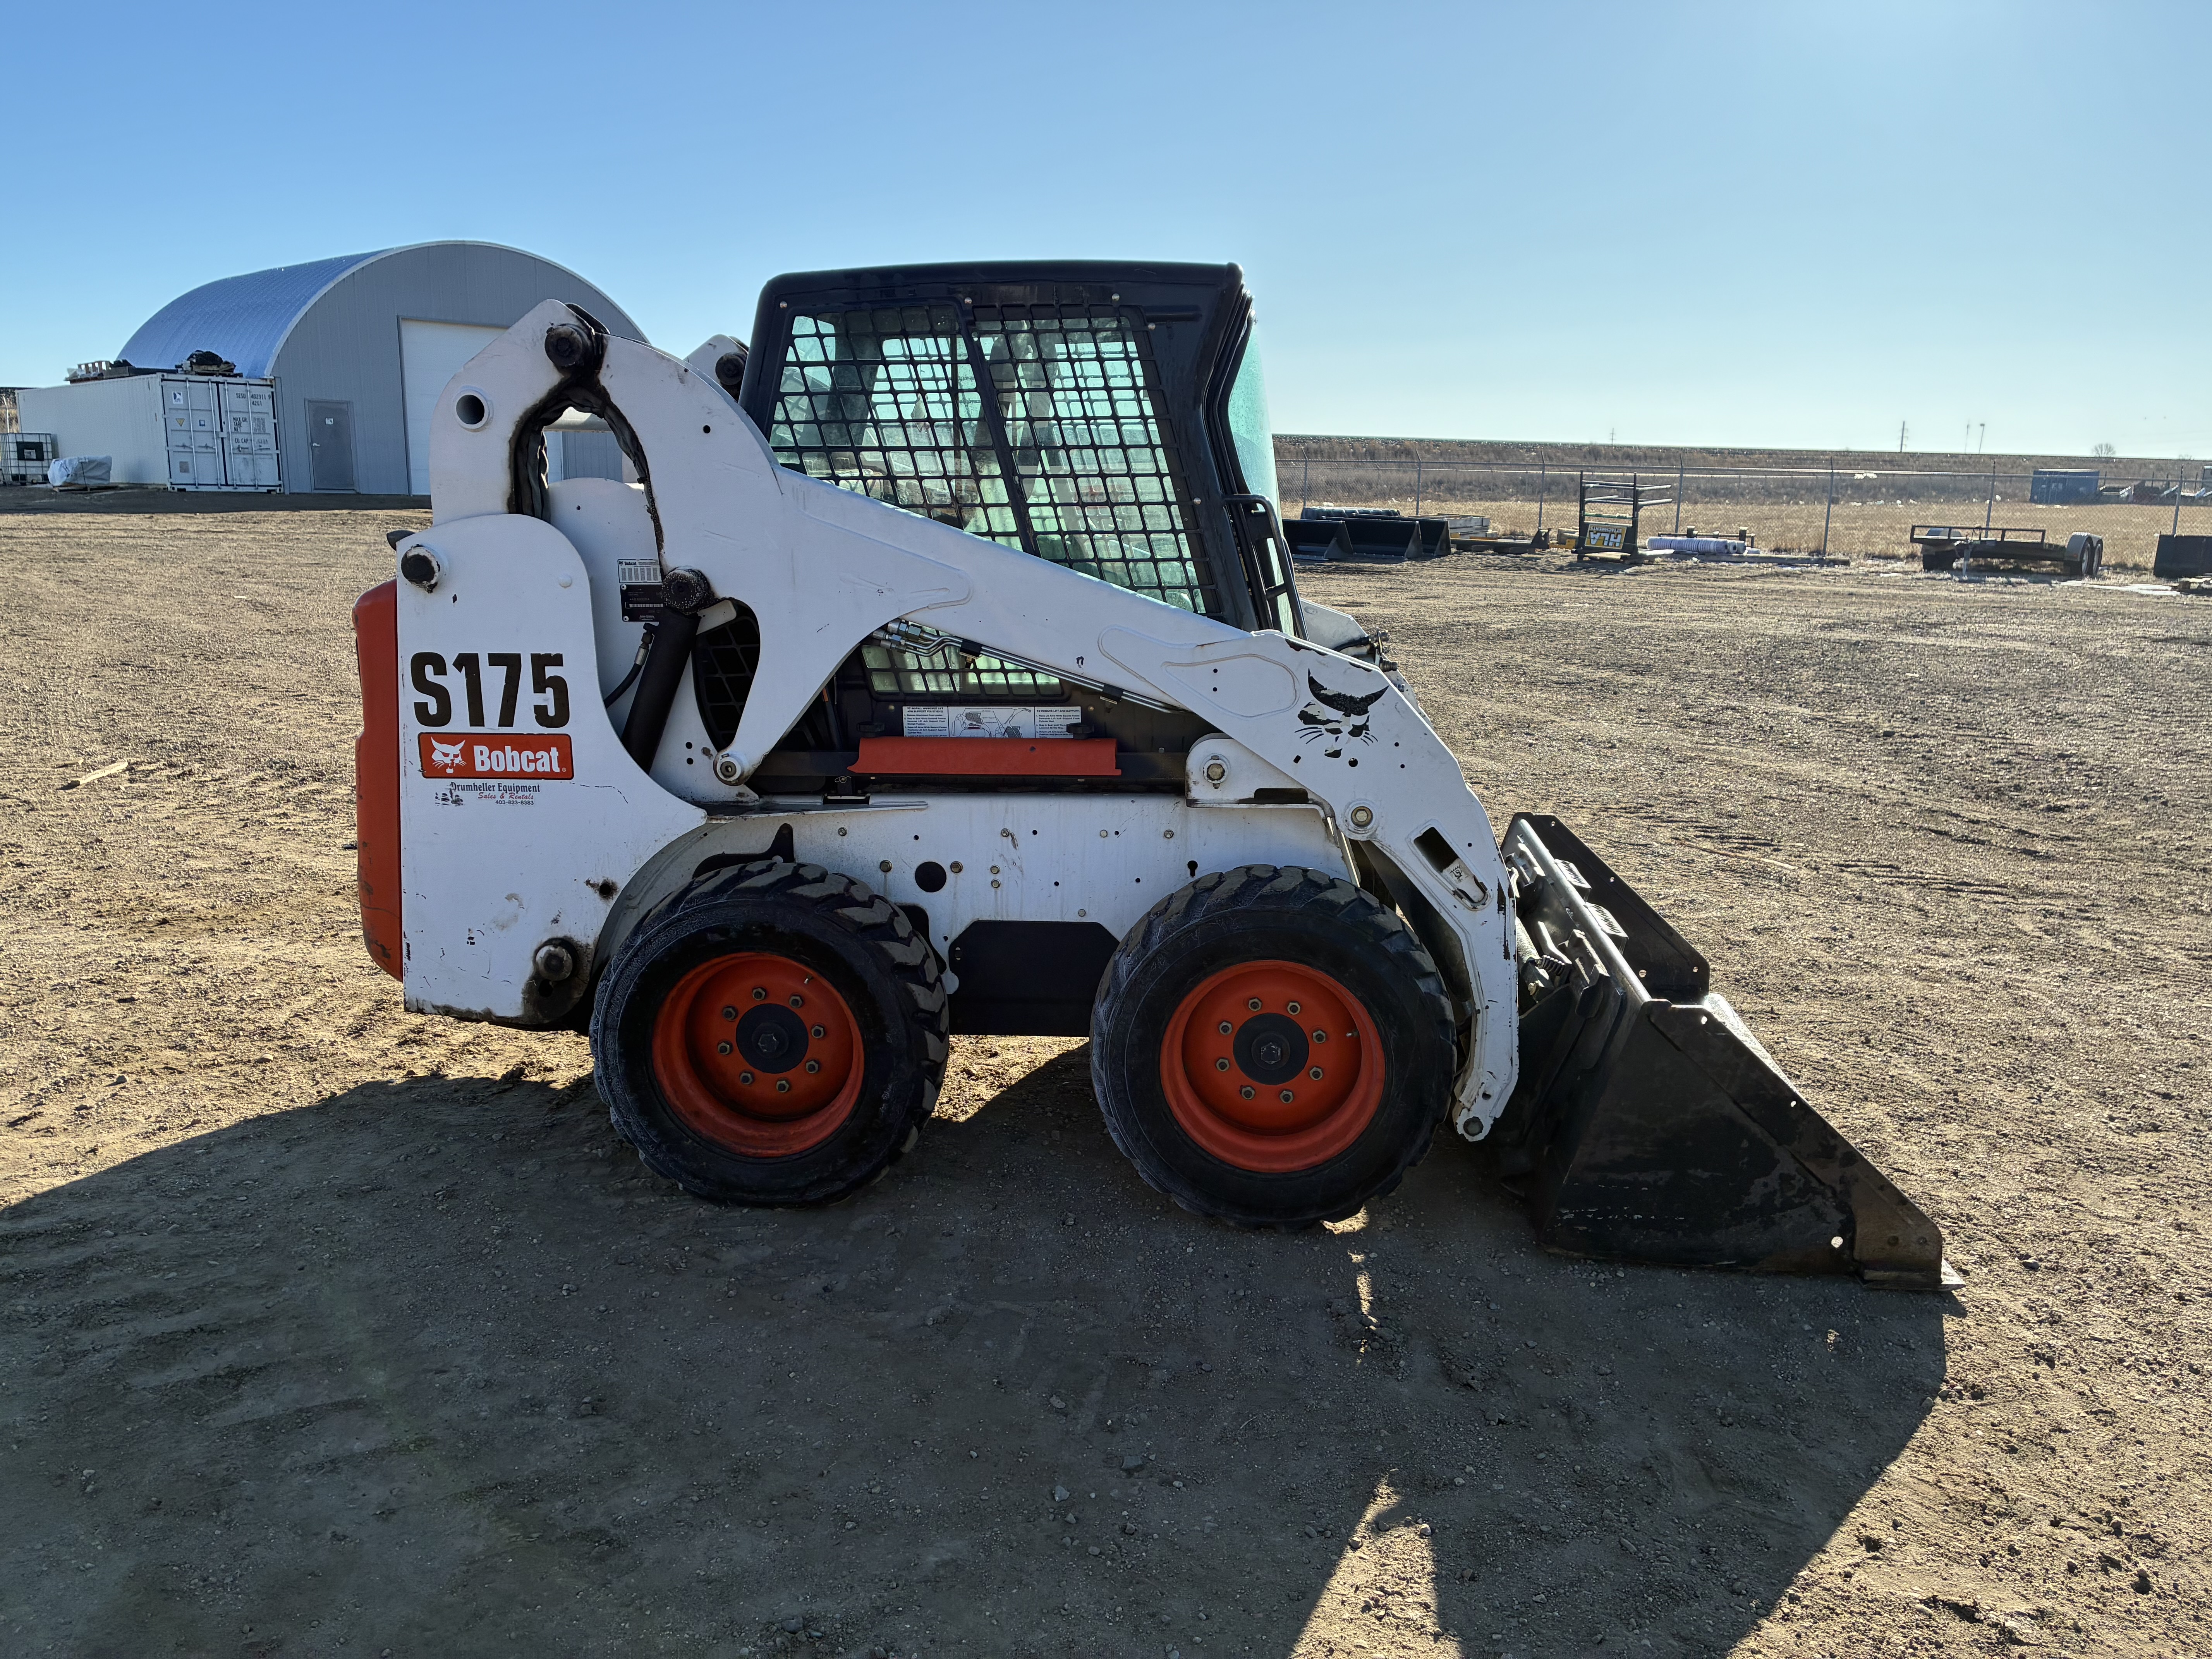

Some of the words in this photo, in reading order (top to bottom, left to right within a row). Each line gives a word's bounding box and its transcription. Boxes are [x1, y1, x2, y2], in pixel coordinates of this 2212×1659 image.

[1590, 532, 1622, 546] HLA
[410, 652, 570, 728] S175
[473, 745, 560, 772] Bobcat
[451, 782, 496, 792] Drumheller
[498, 783, 541, 793] Equipment
